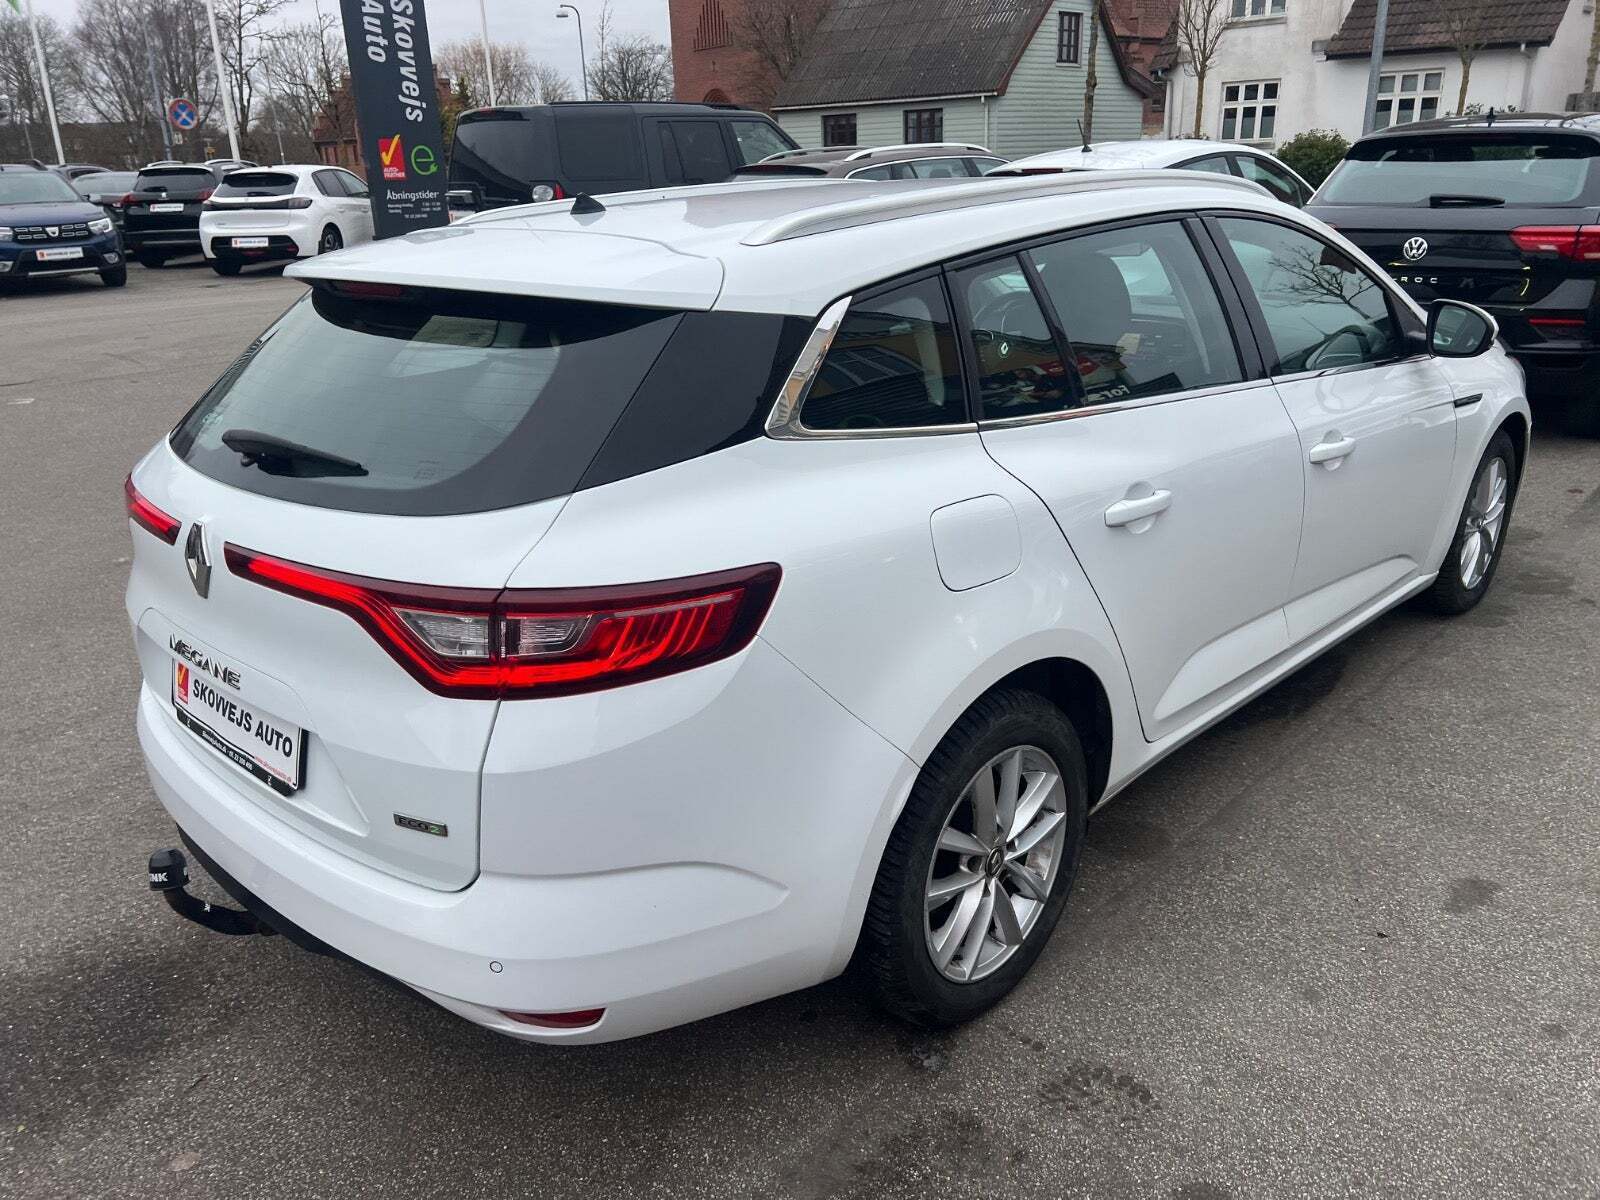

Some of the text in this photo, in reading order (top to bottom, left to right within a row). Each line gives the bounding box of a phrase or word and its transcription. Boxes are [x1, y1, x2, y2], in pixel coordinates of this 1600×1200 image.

[361, 0, 389, 62] Auto
[390, 0, 426, 122] Skovvejs
[170, 633, 241, 690] MEGANE
[193, 679, 253, 733] SKOVVEJS
[255, 720, 293, 758] AUTO
